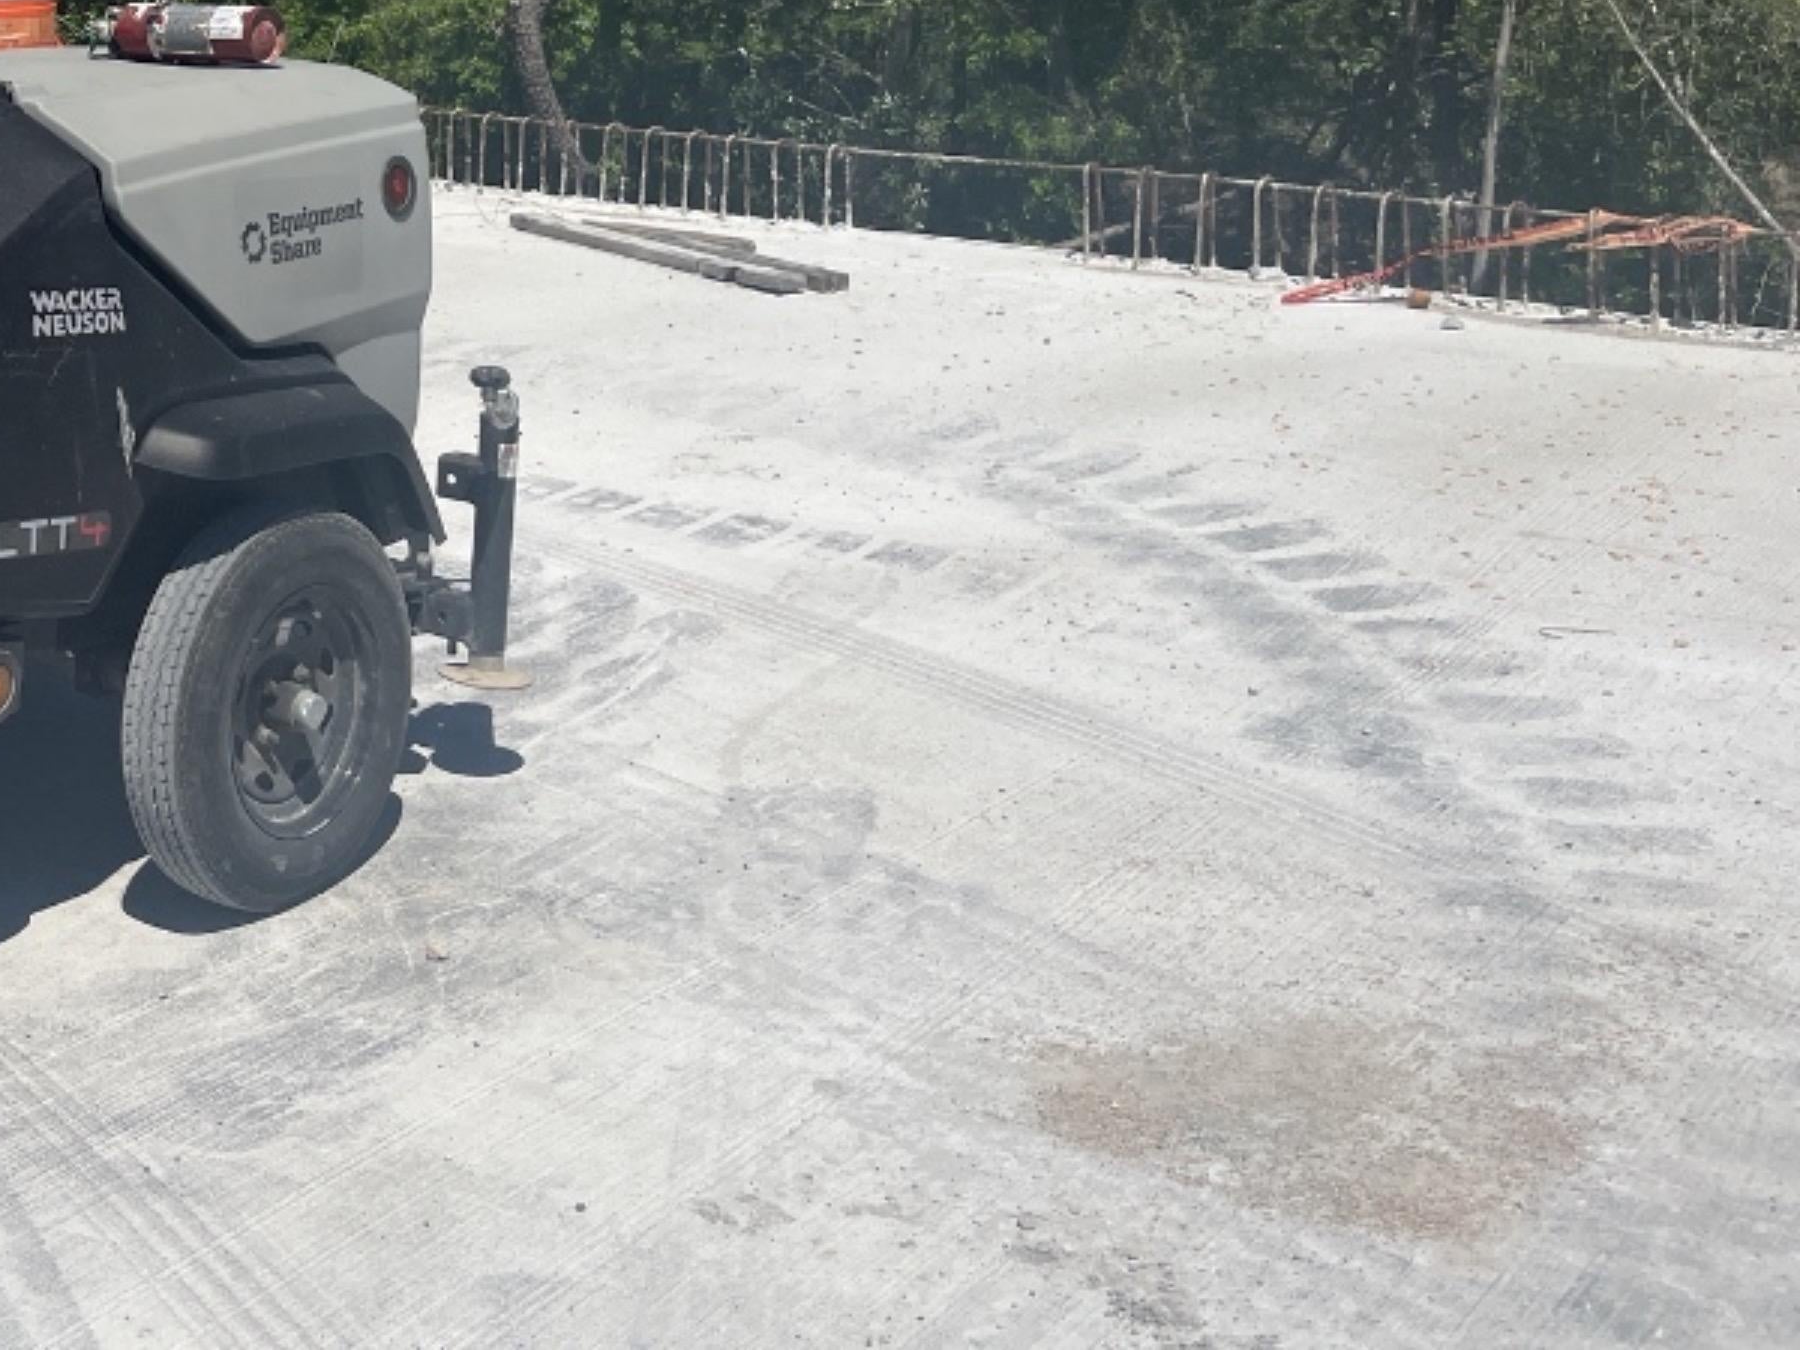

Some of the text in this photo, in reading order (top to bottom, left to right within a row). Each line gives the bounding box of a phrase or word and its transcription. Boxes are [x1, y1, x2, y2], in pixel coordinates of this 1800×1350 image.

[267, 198, 364, 238] Equipment
[270, 236, 322, 265] Share
[29, 287, 124, 313] WACKER
[32, 310, 126, 338] NEUSON
